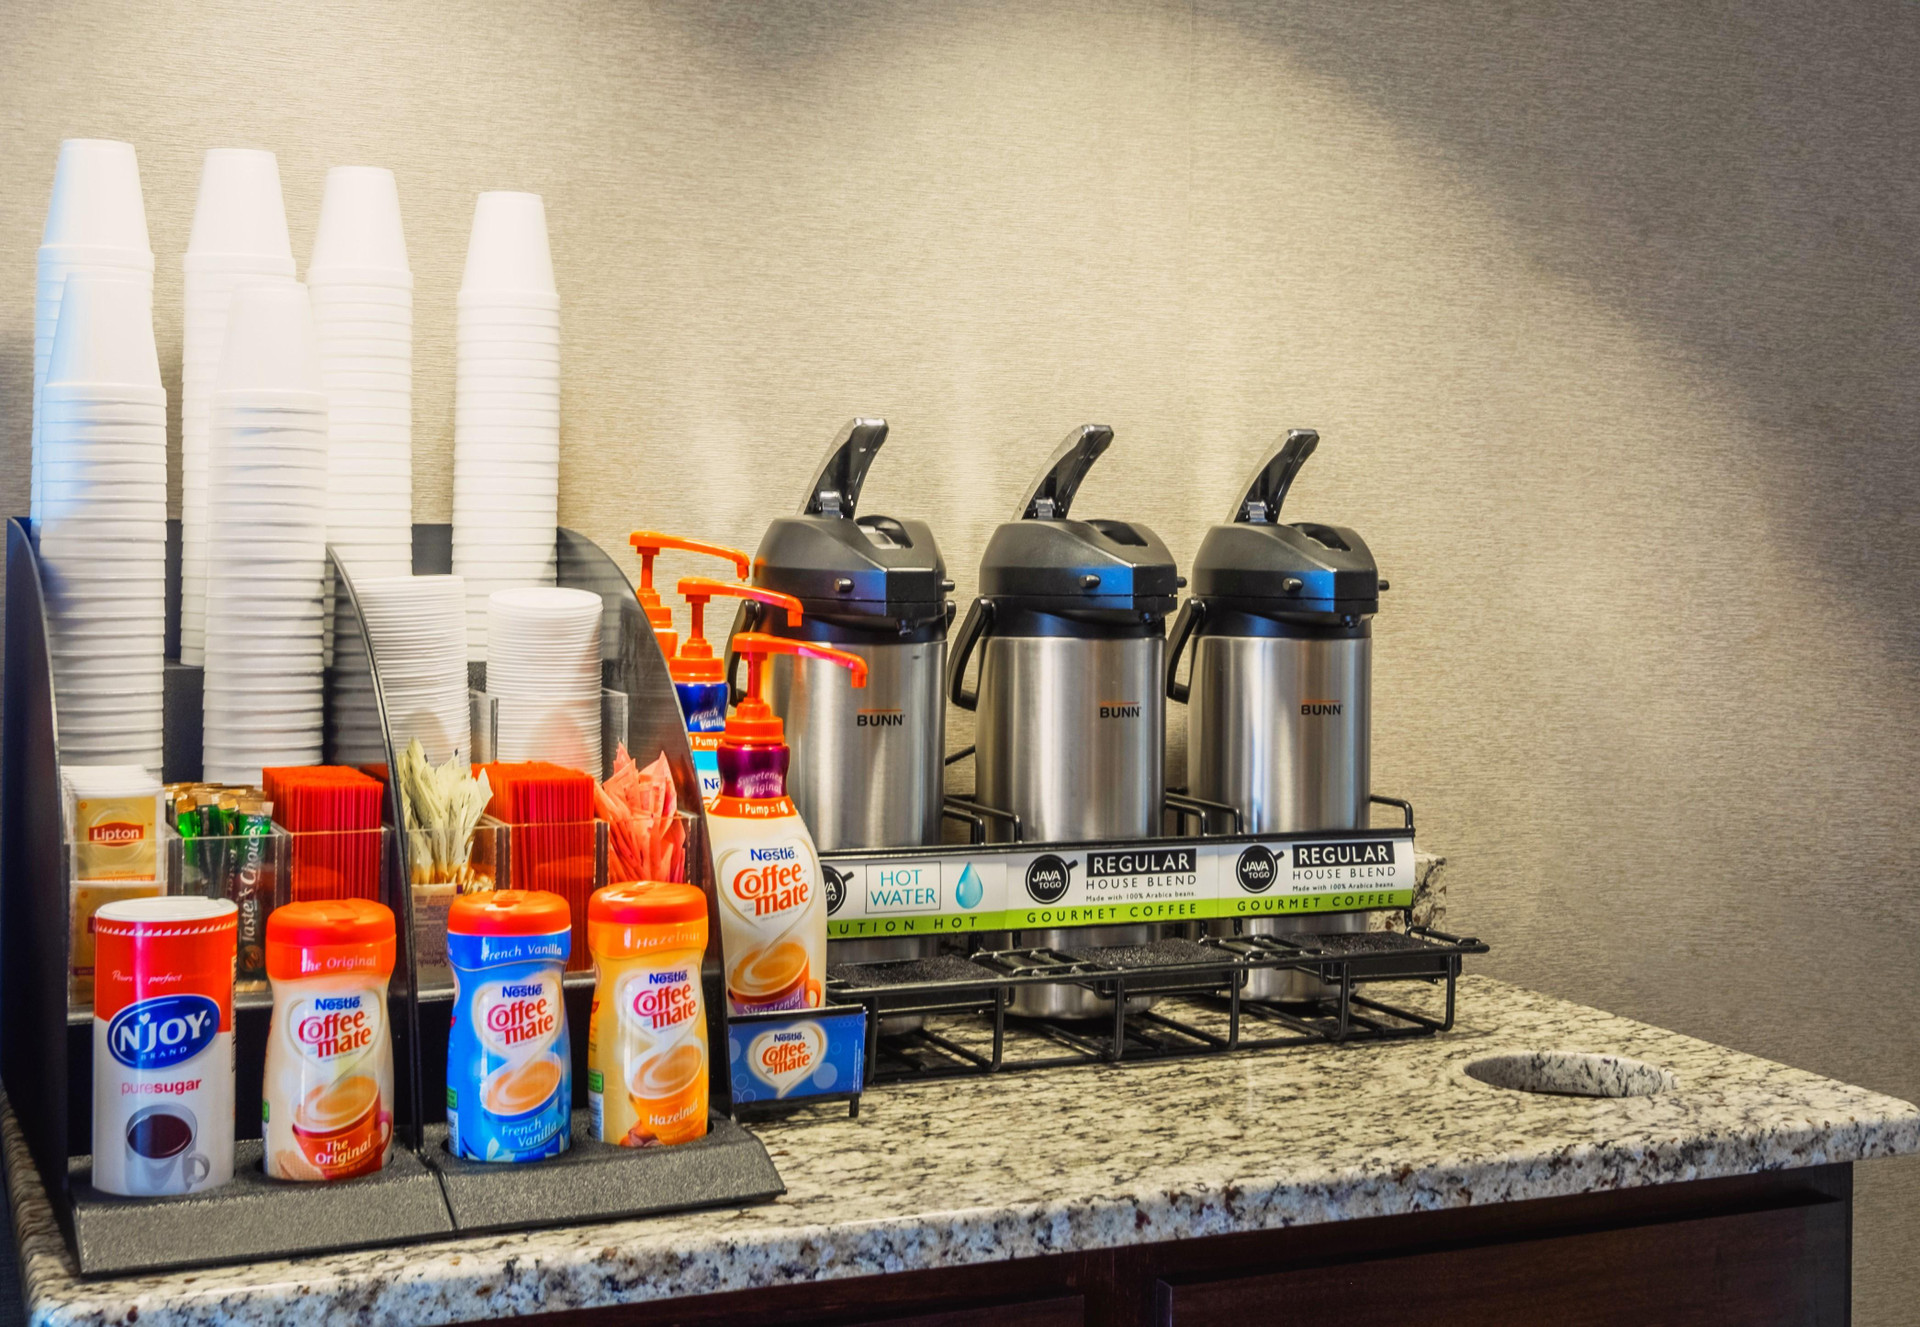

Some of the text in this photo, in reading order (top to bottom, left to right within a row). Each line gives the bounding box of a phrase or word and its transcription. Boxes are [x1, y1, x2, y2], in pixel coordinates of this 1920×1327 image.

[1100, 706, 1140, 718] BUNN
[1301, 704, 1341, 715] BUNN
[857, 714, 903, 726] BUNN
[695, 736, 718, 748] Pump
[739, 803, 743, 814] 1
[745, 803, 769, 817] Pump
[93, 828, 140, 843] Lipton
[1093, 853, 1190, 874] REGULAR
[1299, 844, 1389, 865] REGULAR
[1242, 860, 1269, 872] JAVA
[1292, 865, 1396, 881] HOUSE BLEND
[733, 863, 802, 900] Coffee
[880, 869, 922, 887] HOT
[1032, 869, 1061, 882] JAVA
[1086, 874, 1197, 890] HOUSE BLEND
[1349, 881, 1373, 889] Arabica
[755, 883, 808, 917] mate
[870, 888, 936, 907] WATER
[1107, 893, 1123, 901] with
[1126, 892, 1143, 900] 100%
[1146, 890, 1172, 899] Arabica
[1237, 893, 1395, 912] GOURMET COFFEE
[1027, 903, 1197, 923] GOURMET COFFEE
[827, 915, 978, 935] UTION HOT
[636, 931, 700, 949] Hazelnut
[481, 944, 562, 961] rench Vanilla
[302, 956, 376, 973] he Original
[148, 971, 182, 985] perfect
[633, 983, 691, 1017] Coffee
[487, 998, 547, 1032] Coffee
[652, 1000, 697, 1029] mate
[298, 1010, 365, 1044] Coffee
[504, 1015, 554, 1045] mate
[317, 1028, 371, 1058] mate
[141, 1046, 187, 1060] BRAND
[762, 1042, 806, 1067] Coffee
[773, 1053, 810, 1075] mate
[649, 1099, 699, 1126] Hazelnut
[502, 1118, 542, 1136] French
[518, 1121, 557, 1147] Vanilla
[315, 1133, 372, 1166] Original
[326, 1139, 349, 1153] The
